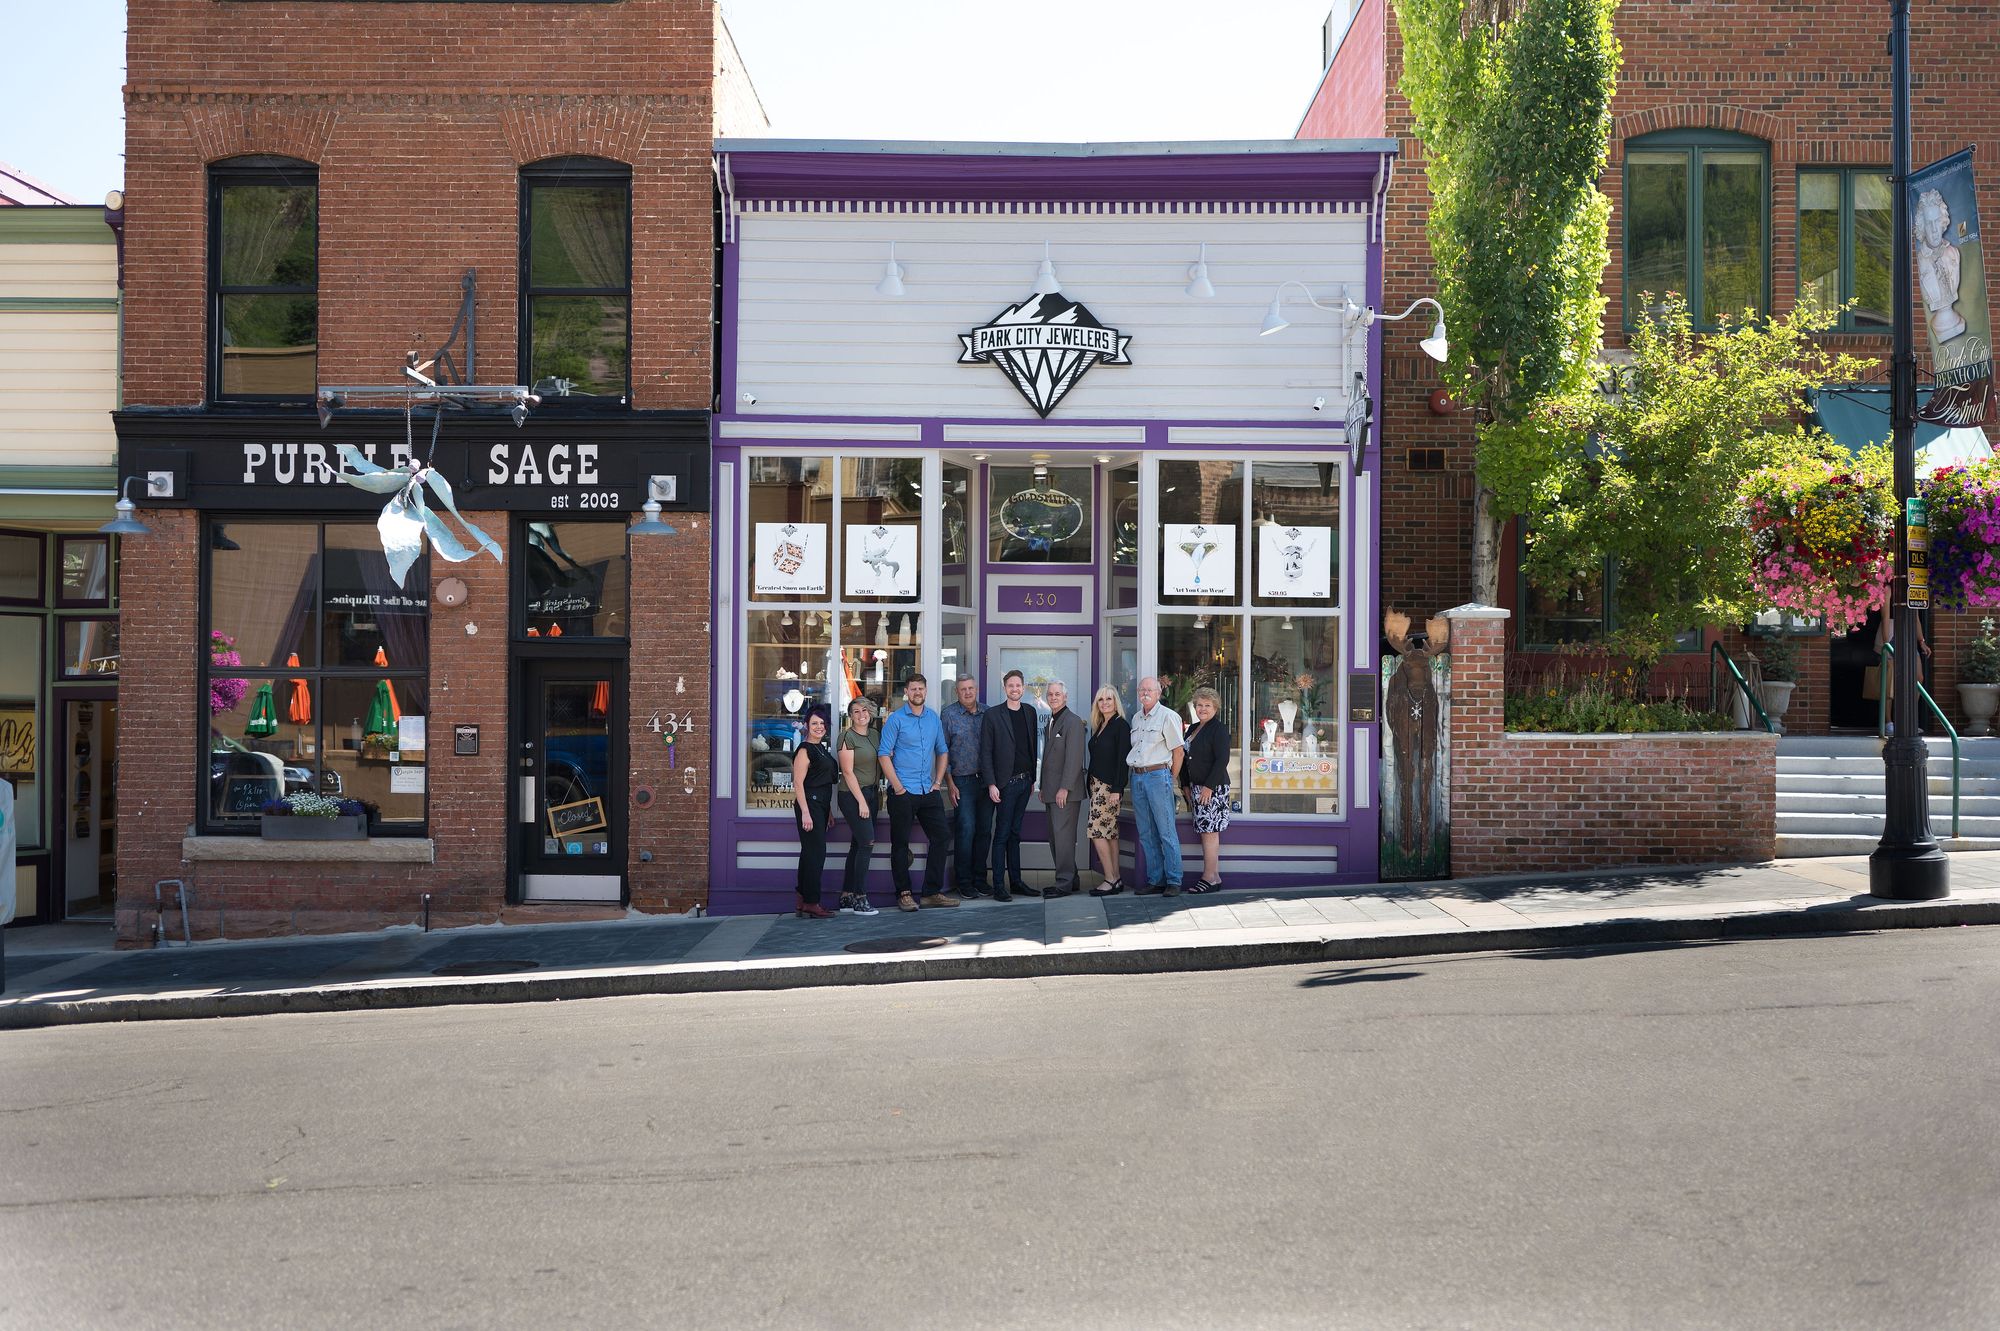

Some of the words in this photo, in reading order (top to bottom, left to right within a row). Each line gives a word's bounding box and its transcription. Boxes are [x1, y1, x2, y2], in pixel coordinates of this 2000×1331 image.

[980, 329, 1011, 349] PARK
[1016, 327, 1042, 345] CITY
[1046, 327, 1110, 350] JEWELERS
[1935, 344, 1967, 372] Park
[1919, 383, 1989, 425] Festival
[488, 443, 599, 485] SAGE
[551, 494, 569, 508] est
[580, 492, 619, 509] 2003
[1008, 492, 1074, 506] GOLDSMITH
[1911, 553, 1925, 564] DLS
[1024, 592, 1058, 606] 430
[1909, 589, 1922, 599] ZONE
[646, 710, 695, 735] 434
[751, 784, 779, 794] OVER
[756, 798, 767, 808] IN
[560, 806, 590, 825] Closed
